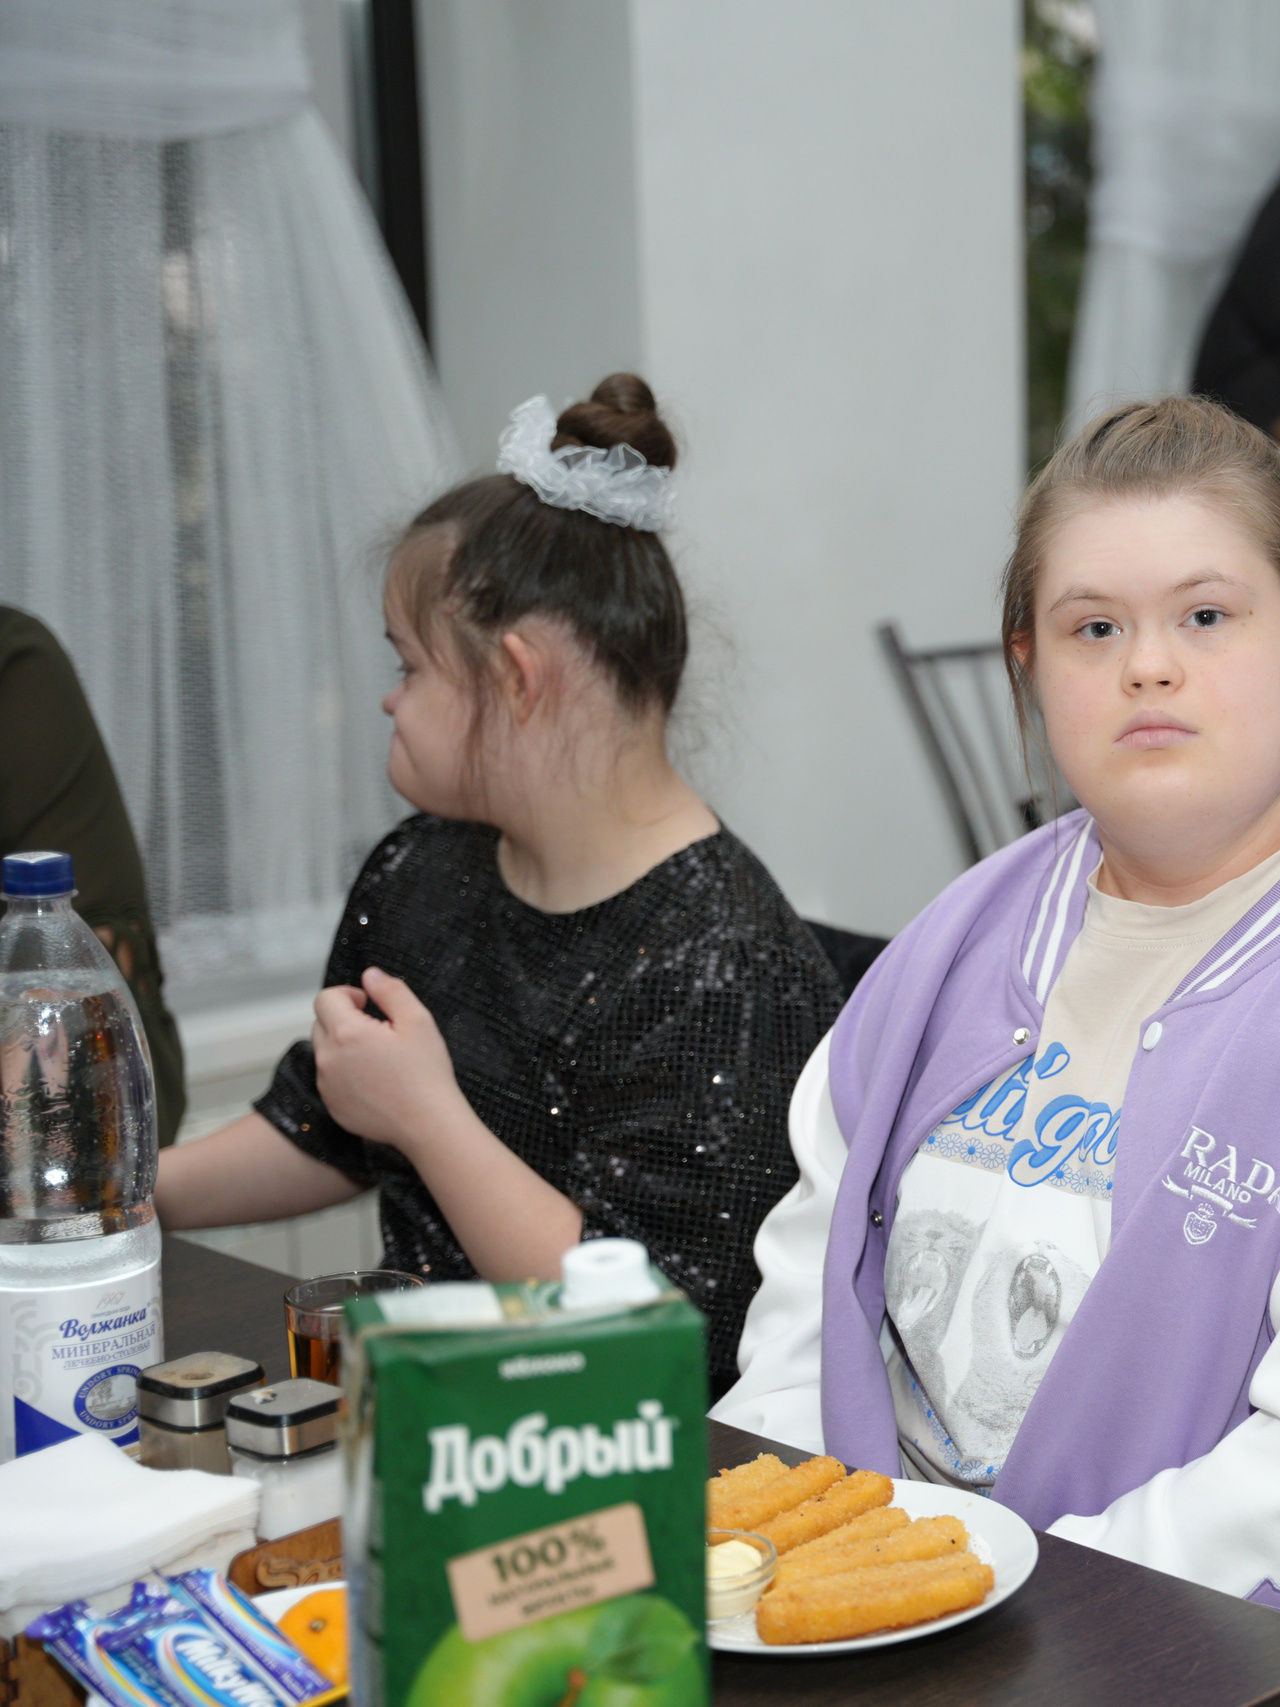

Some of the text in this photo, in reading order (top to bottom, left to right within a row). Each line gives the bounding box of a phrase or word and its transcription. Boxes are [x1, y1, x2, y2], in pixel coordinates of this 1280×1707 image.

[1183, 1161, 1251, 1203] MILANO
[51, 1323, 155, 1360] МИНЕРАЛЬНАЯ
[59, 1307, 147, 1341] Волжанка
[78, 1368, 113, 1399] UNDORY
[80, 1410, 114, 1429] UNDORY
[422, 1400, 674, 1513] Добрый
